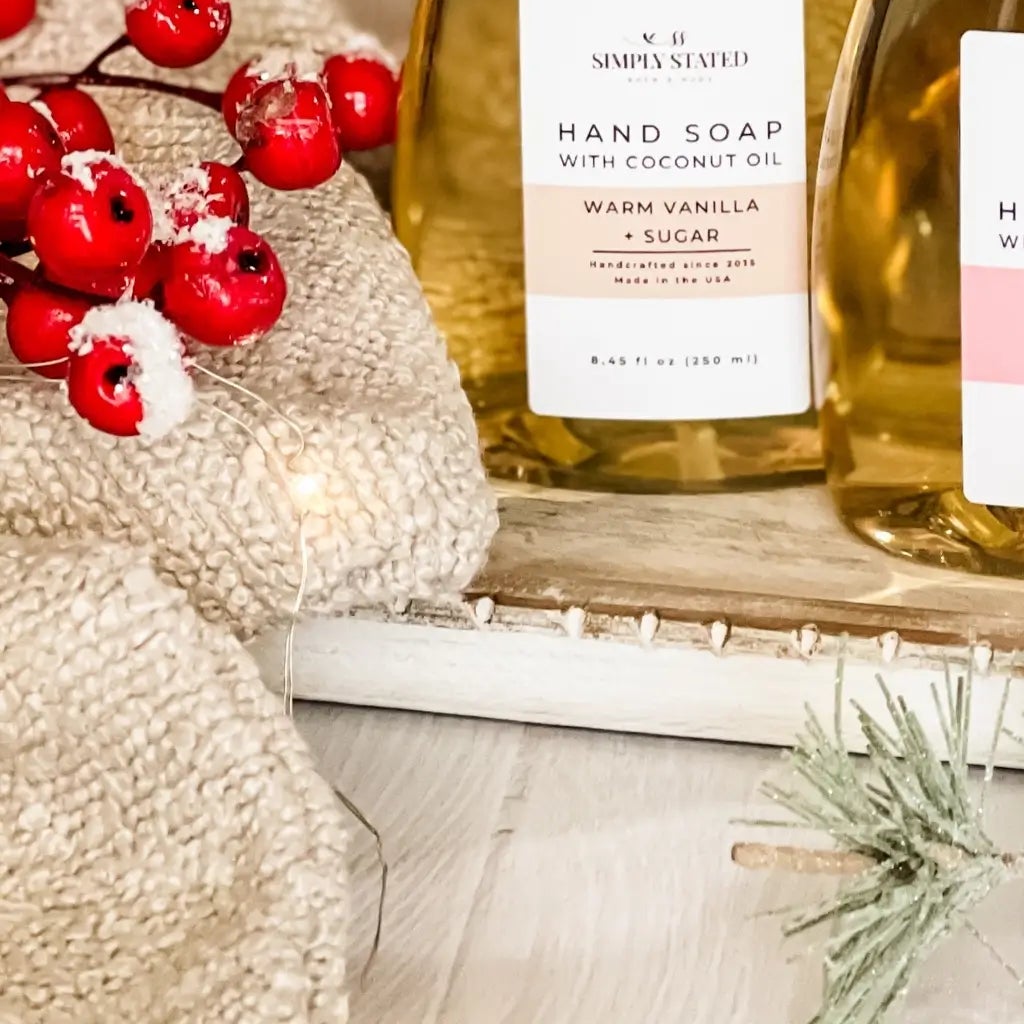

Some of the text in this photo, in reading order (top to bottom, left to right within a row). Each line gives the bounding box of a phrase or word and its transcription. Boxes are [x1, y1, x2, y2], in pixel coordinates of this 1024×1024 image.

[591, 51, 749, 69] SIMPLY STATED
[559, 121, 782, 143] HAND SOAP
[559, 152, 782, 169] WITH COCONUT OIL
[584, 198, 760, 214] WARM VANILLA
[624, 229, 720, 243] + SUGAR
[590, 259, 756, 269] Handcrafted since 2015
[614, 275, 731, 285] Made in the USA
[591, 354, 759, 367] 8.45 fl oz (250 ml)
